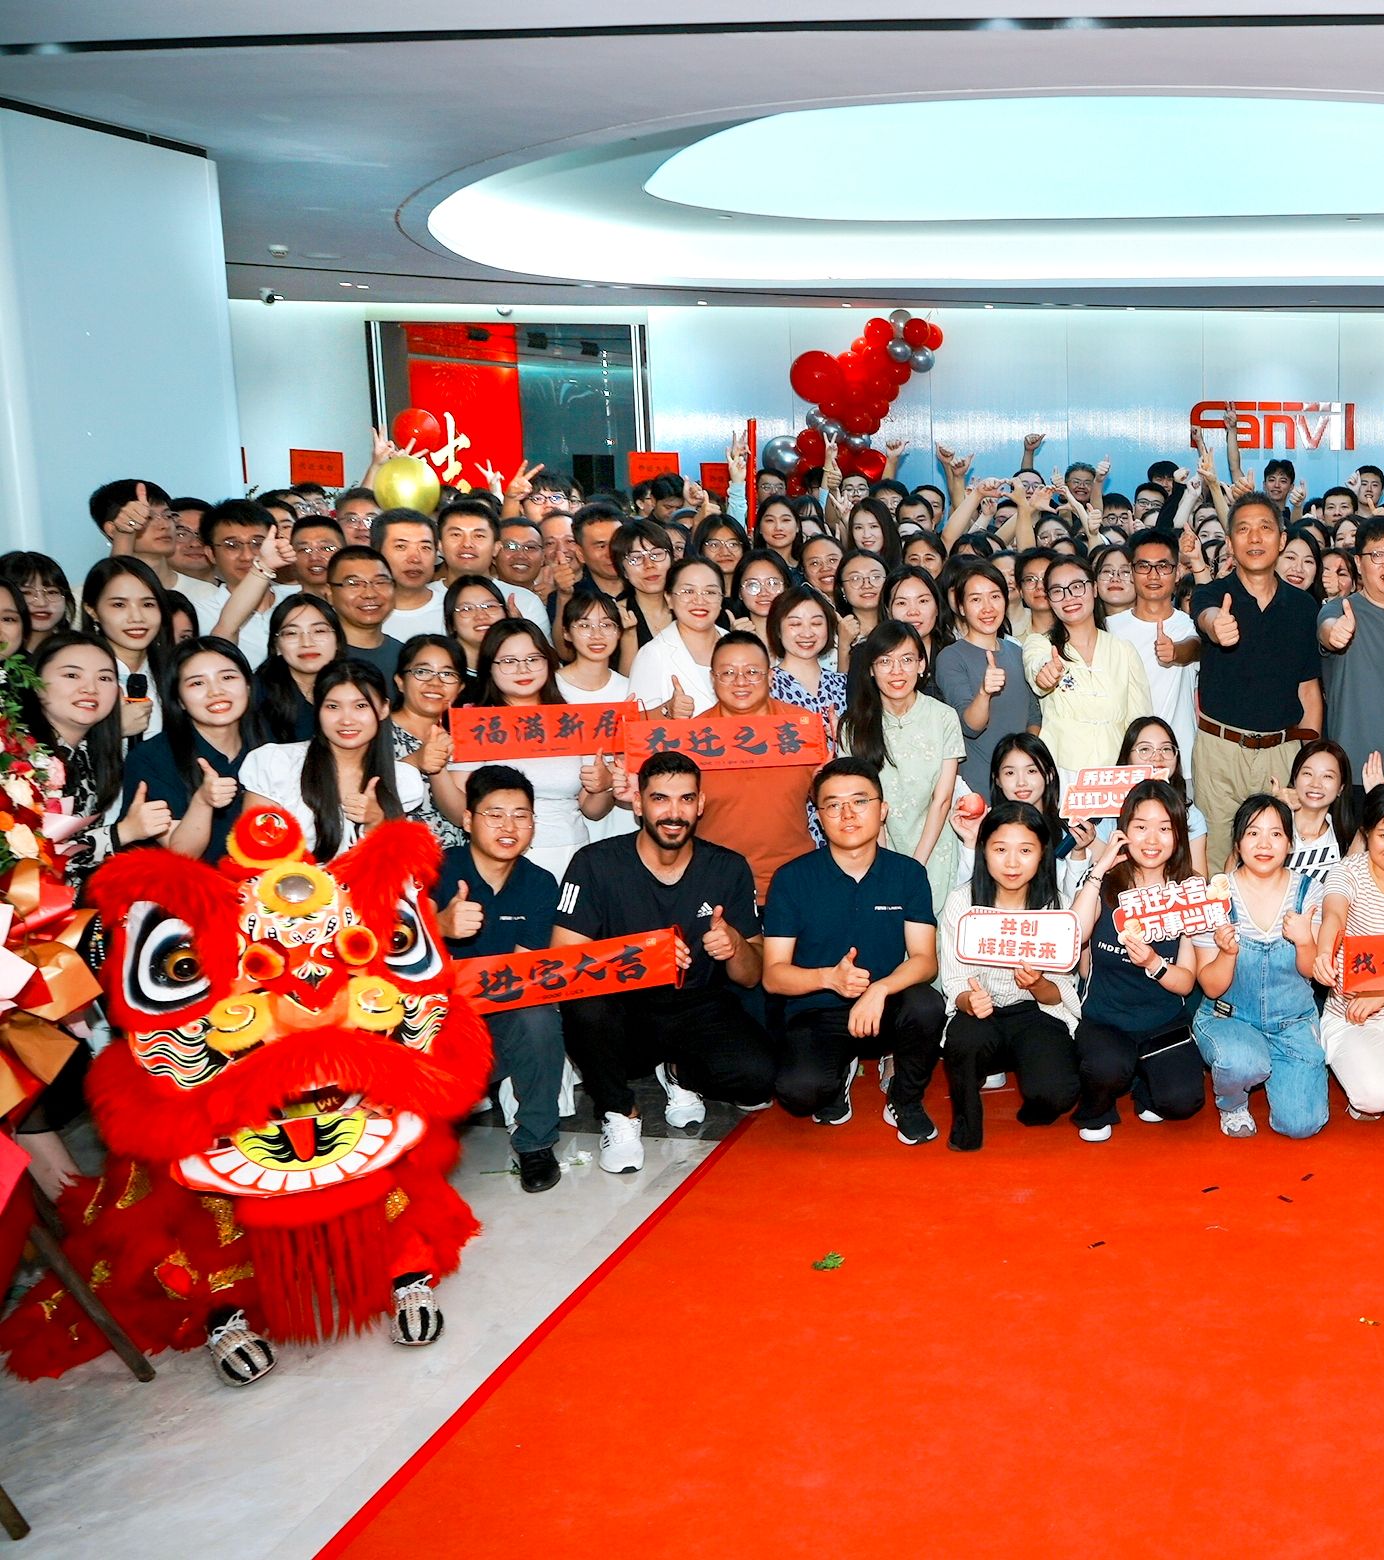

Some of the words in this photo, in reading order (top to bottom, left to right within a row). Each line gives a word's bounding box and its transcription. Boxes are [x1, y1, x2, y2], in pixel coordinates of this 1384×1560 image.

[1190, 401, 1355, 450] Fanvil
[470, 709, 617, 745] 福满新居
[645, 720, 806, 757] 乔迁之喜
[1083, 769, 1146, 786] 乔迁大吉
[1119, 878, 1207, 918] 乔迁大吉
[1000, 918, 1039, 936] 共创
[1140, 902, 1228, 942] 万事兴隆
[978, 938, 1057, 959] 辉煌未来
[1098, 941, 1174, 964] INDEPCE
